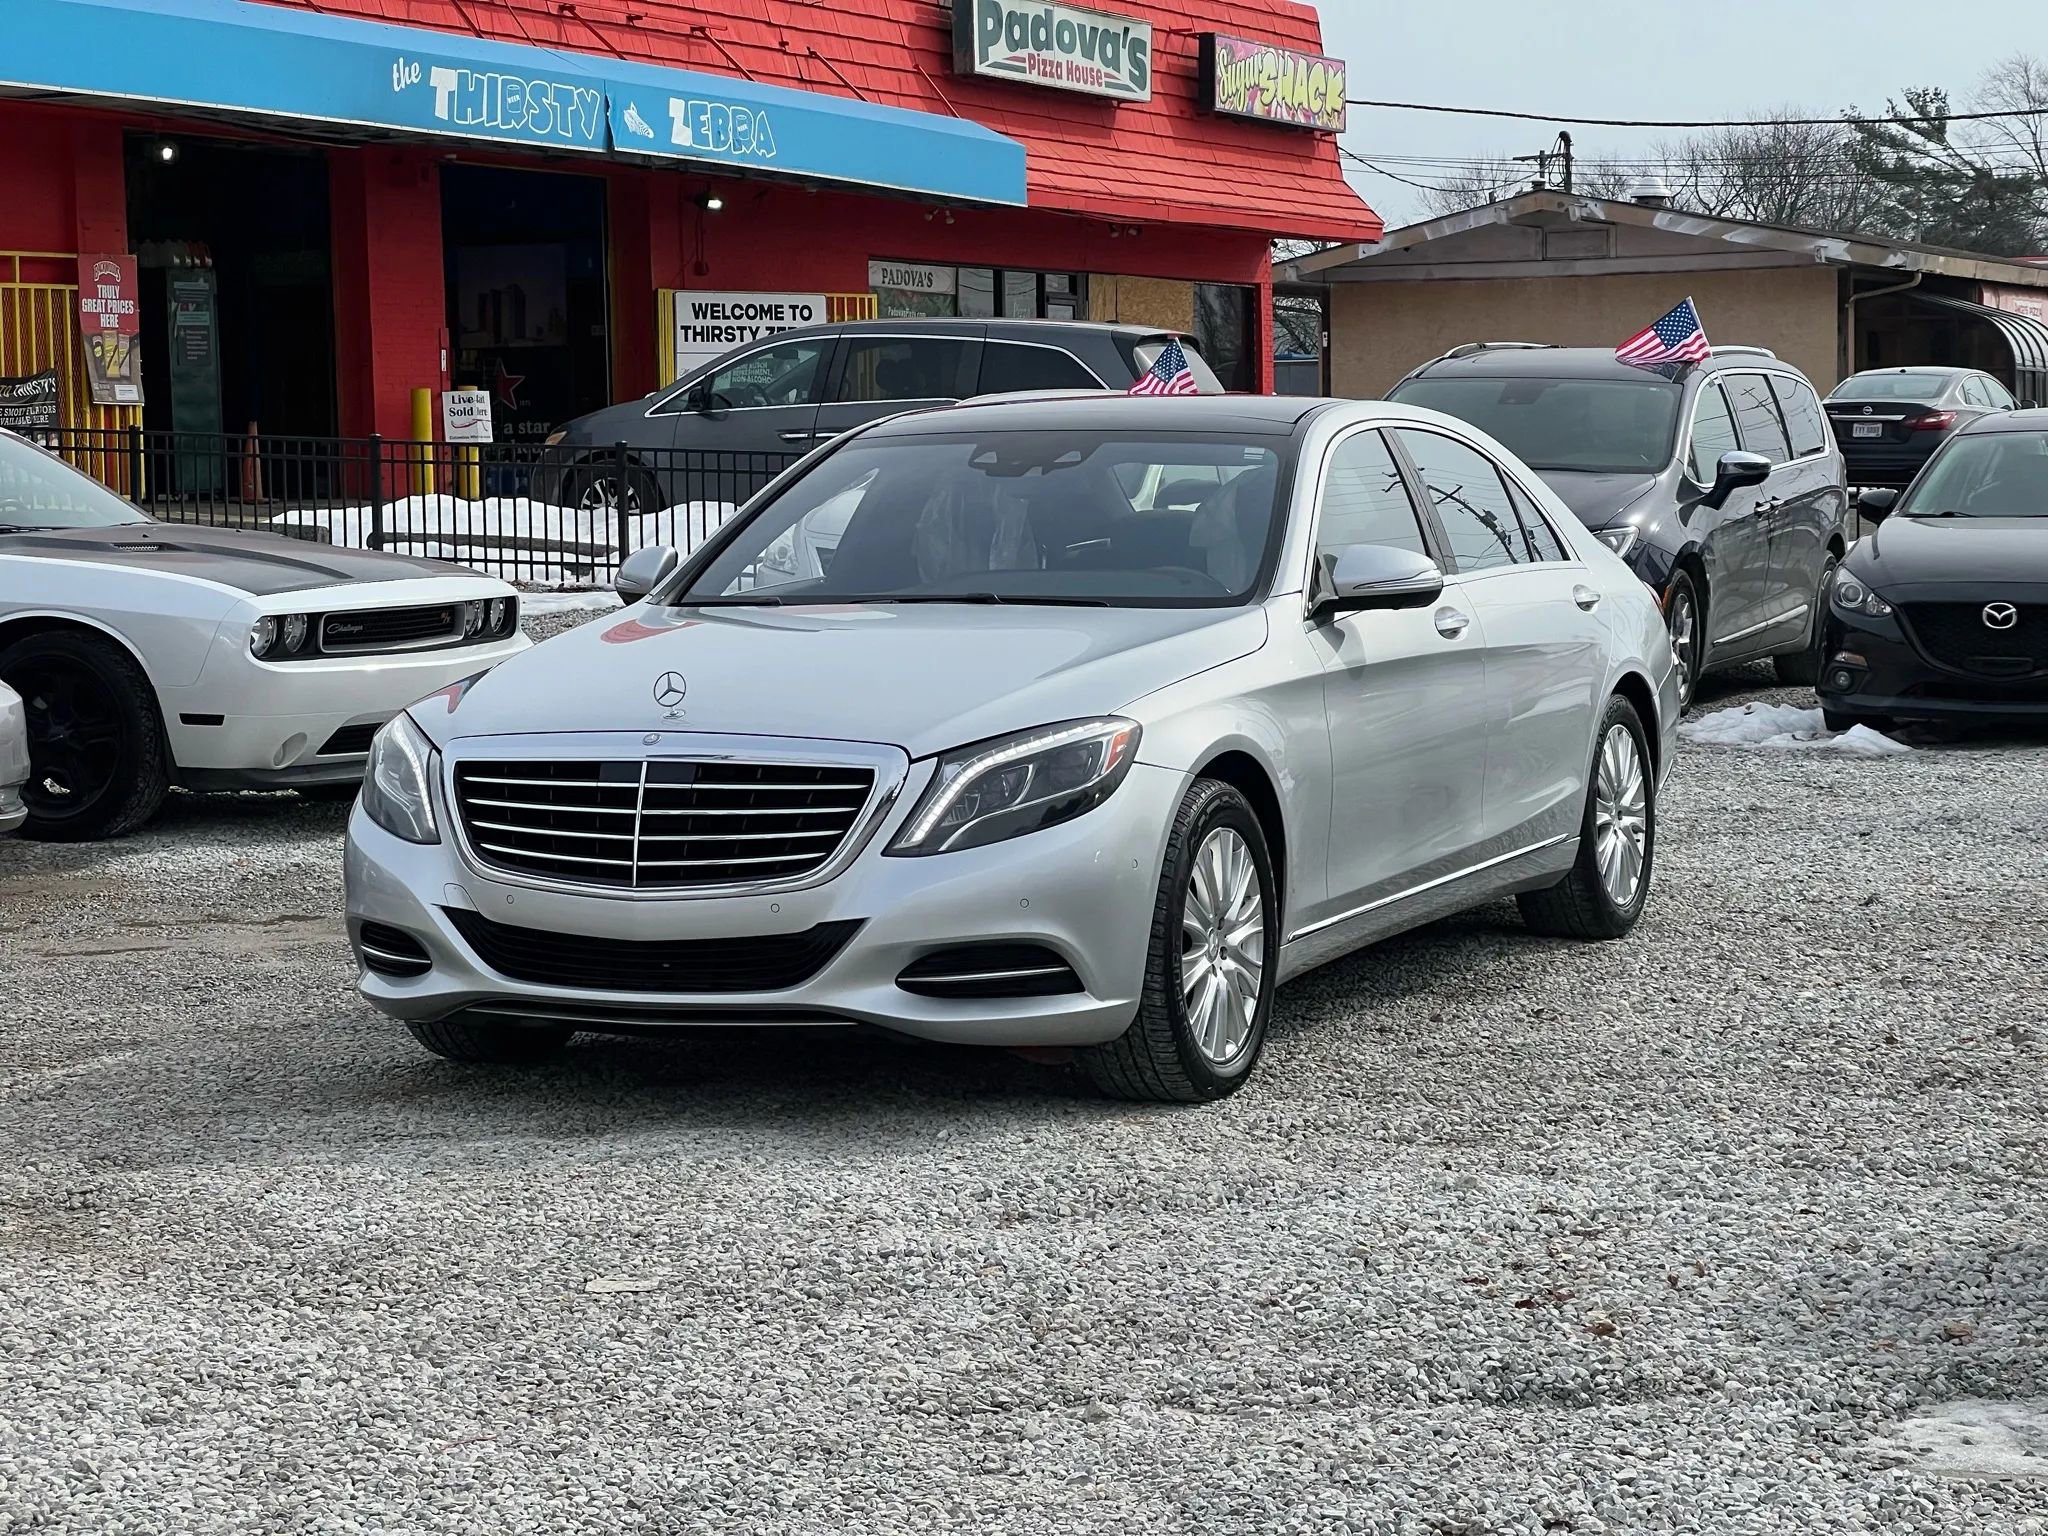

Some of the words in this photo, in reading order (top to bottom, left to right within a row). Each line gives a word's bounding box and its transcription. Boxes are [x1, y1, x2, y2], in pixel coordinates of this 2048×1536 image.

[977, 0, 1148, 93] Padova's
[1027, 52, 1064, 80] Pizza
[1065, 59, 1105, 88] House
[1217, 47, 1264, 112] Sugar
[1259, 51, 1344, 117] SHACK
[393, 57, 421, 92] the
[430, 66, 600, 139] THIRSTY
[669, 97, 777, 158] ZEBRA
[881, 267, 934, 288] PADOVA'S
[97, 284, 120, 299] TRULY
[82, 298, 106, 313] GREAT
[107, 299, 134, 314] PRICES
[691, 302, 785, 321] WELCOME
[789, 304, 813, 321] TO
[100, 313, 119, 328] HERE
[680, 325, 760, 342] THIRSTY
[451, 394, 474, 405] Live
[448, 406, 474, 417] Sold
[518, 420, 551, 435] star
